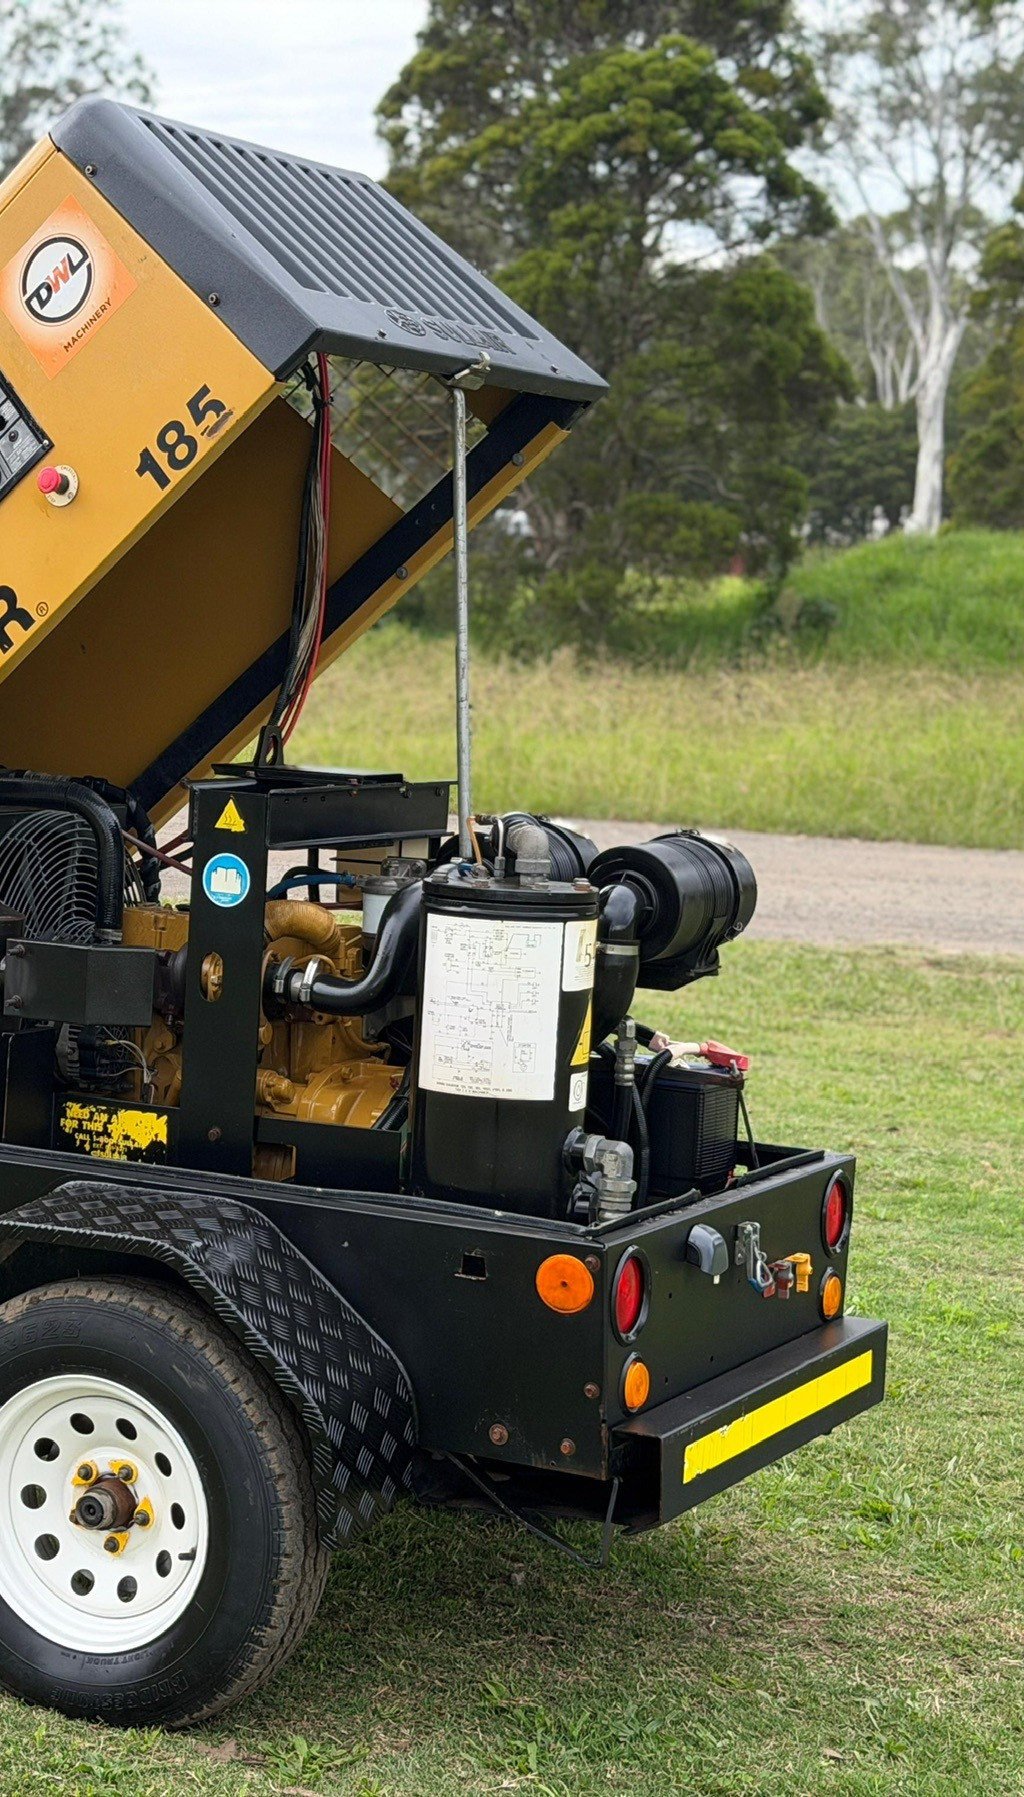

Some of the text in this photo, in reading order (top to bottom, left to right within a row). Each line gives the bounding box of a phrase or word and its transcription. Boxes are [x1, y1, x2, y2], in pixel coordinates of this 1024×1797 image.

[25, 252, 89, 310] DWL
[63, 297, 112, 353] MACHINERY
[135, 383, 230, 491] 185
[60, 1117, 79, 1129] FOR
[82, 1120, 104, 1132] THIS
